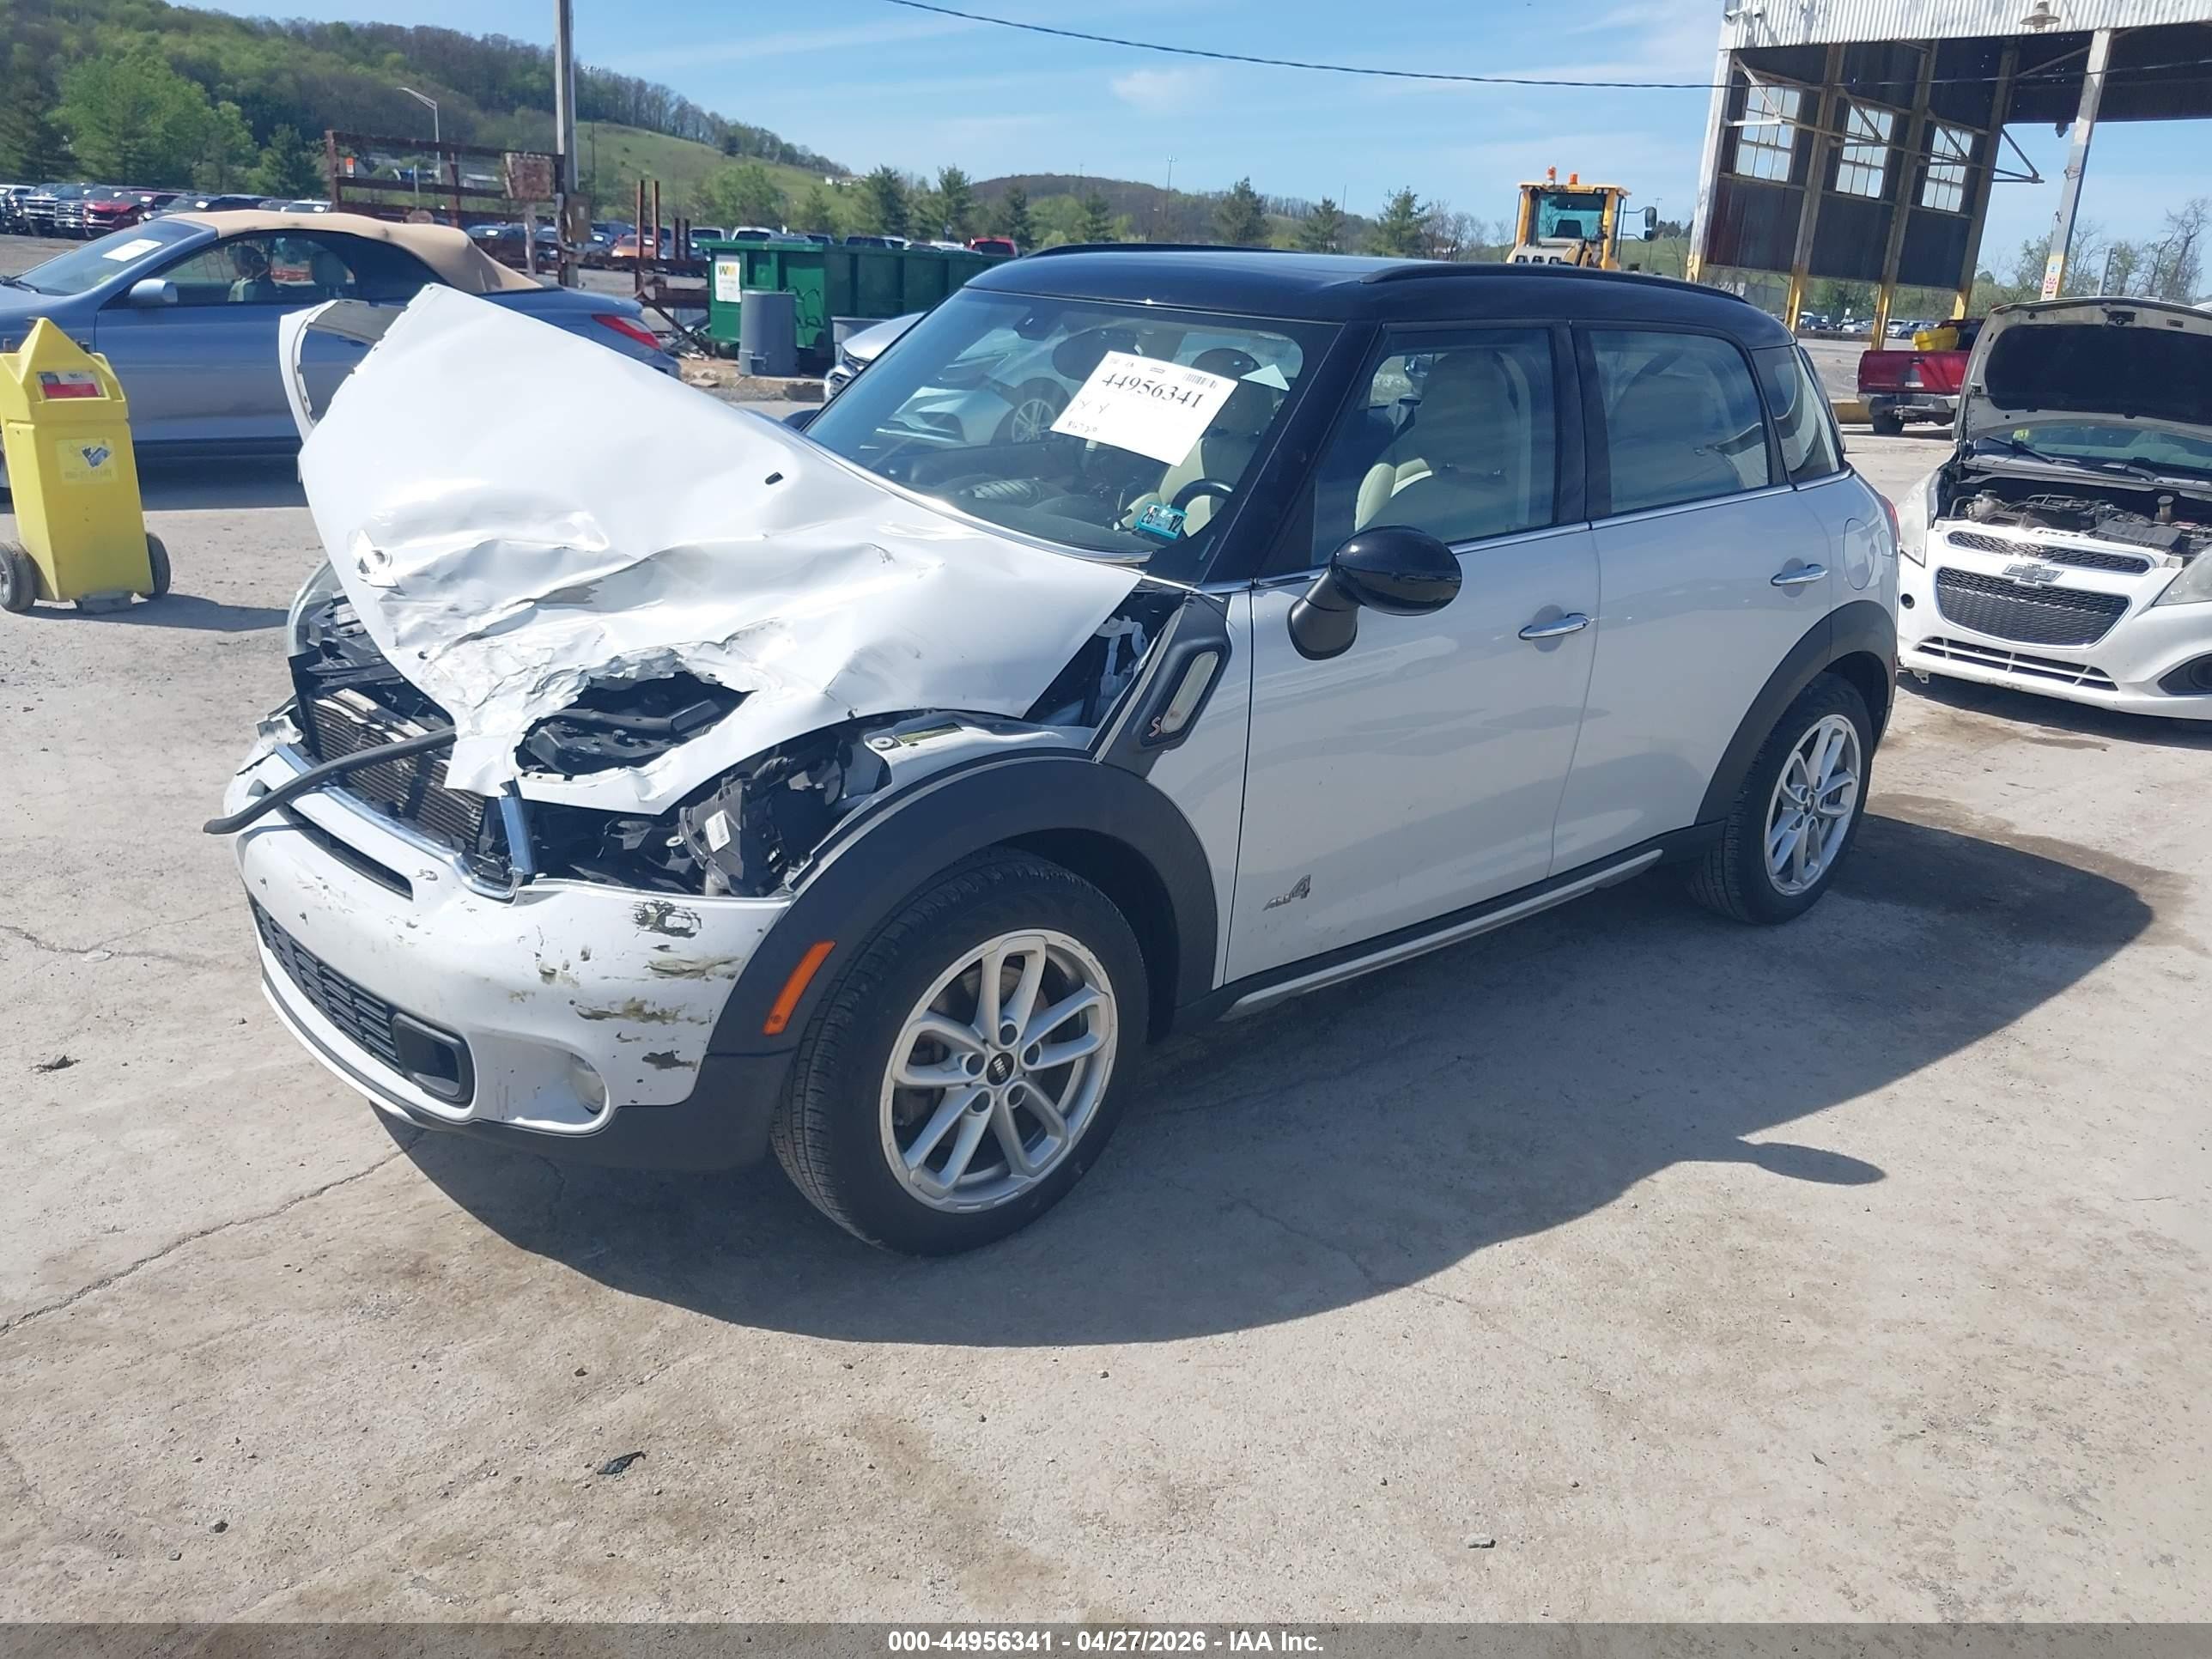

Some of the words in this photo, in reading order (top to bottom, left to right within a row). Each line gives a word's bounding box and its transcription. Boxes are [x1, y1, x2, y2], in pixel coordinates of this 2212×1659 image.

[719, 265, 737, 276] WM
[1102, 373, 1205, 409] 44956341
[1168, 514, 1184, 533] 12
[1148, 716, 1161, 738] S
